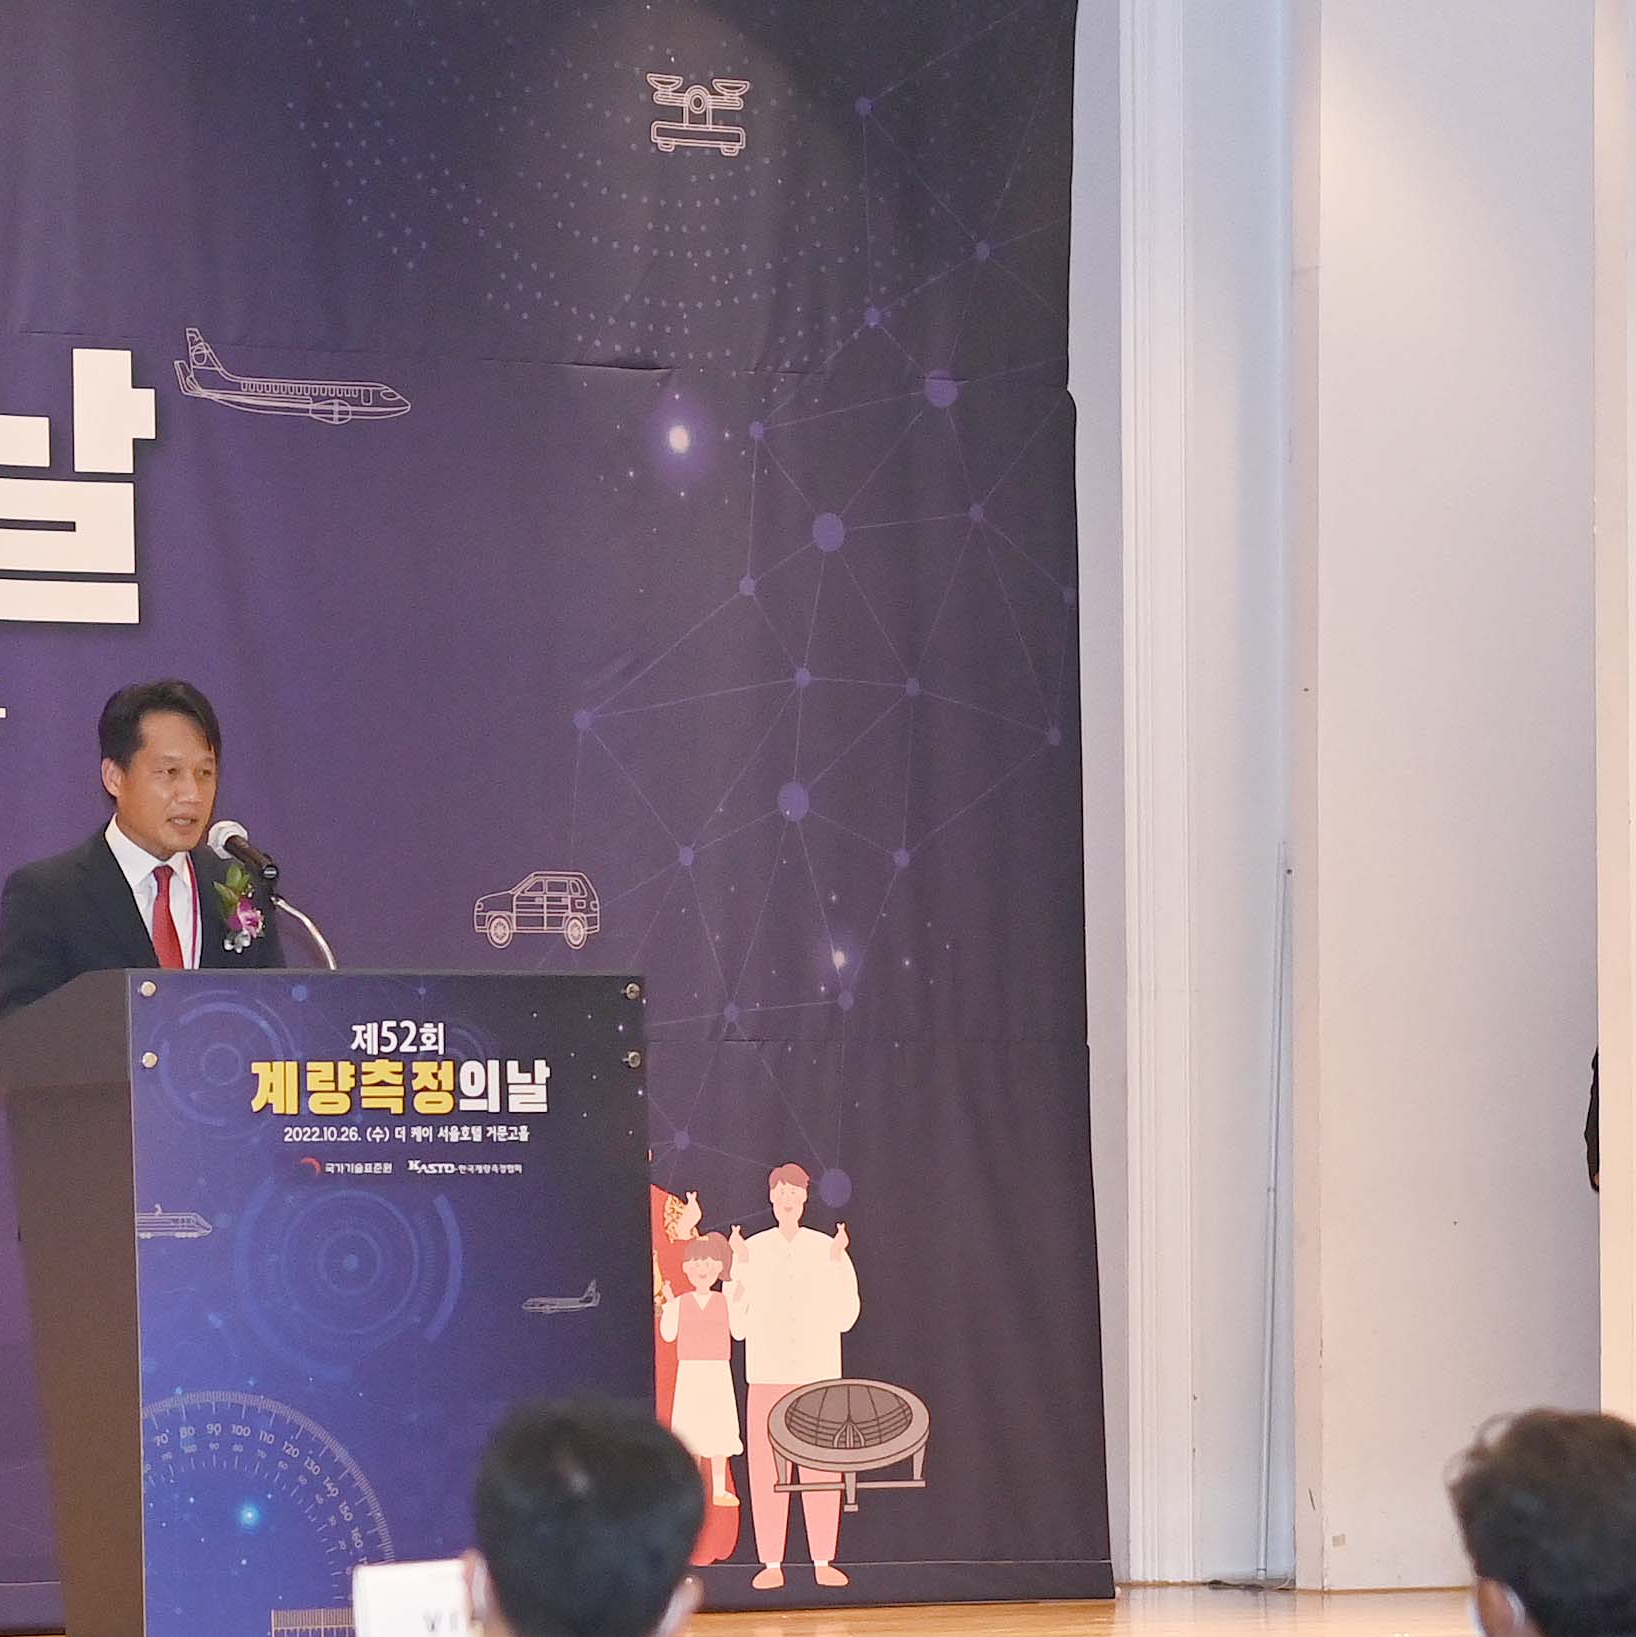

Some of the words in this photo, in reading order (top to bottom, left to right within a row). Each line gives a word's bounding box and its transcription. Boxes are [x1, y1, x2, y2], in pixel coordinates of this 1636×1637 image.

[350, 1020, 445, 1056] 제52회
[251, 1059, 550, 1114] 계량측정의날
[283, 1126, 362, 1142] 2022.10.26.
[366, 1126, 390, 1143] (수)
[394, 1126, 406, 1143] 더
[410, 1125, 433, 1143] 케이
[437, 1125, 482, 1142] 서울호텔
[486, 1125, 530, 1142] 거문고홀
[324, 1162, 393, 1175] 국가기술표준원
[180, 1426, 195, 1439] 80
[206, 1423, 222, 1436] 90
[231, 1423, 251, 1437] 100
[259, 1430, 275, 1444] 110
[283, 1440, 300, 1458] 120
[304, 1456, 321, 1475] 130
[323, 1476, 339, 1497] 140
[338, 1501, 353, 1521] 150
[351, 1527, 364, 1549] 160
[422, 1609, 460, 1635] VI
